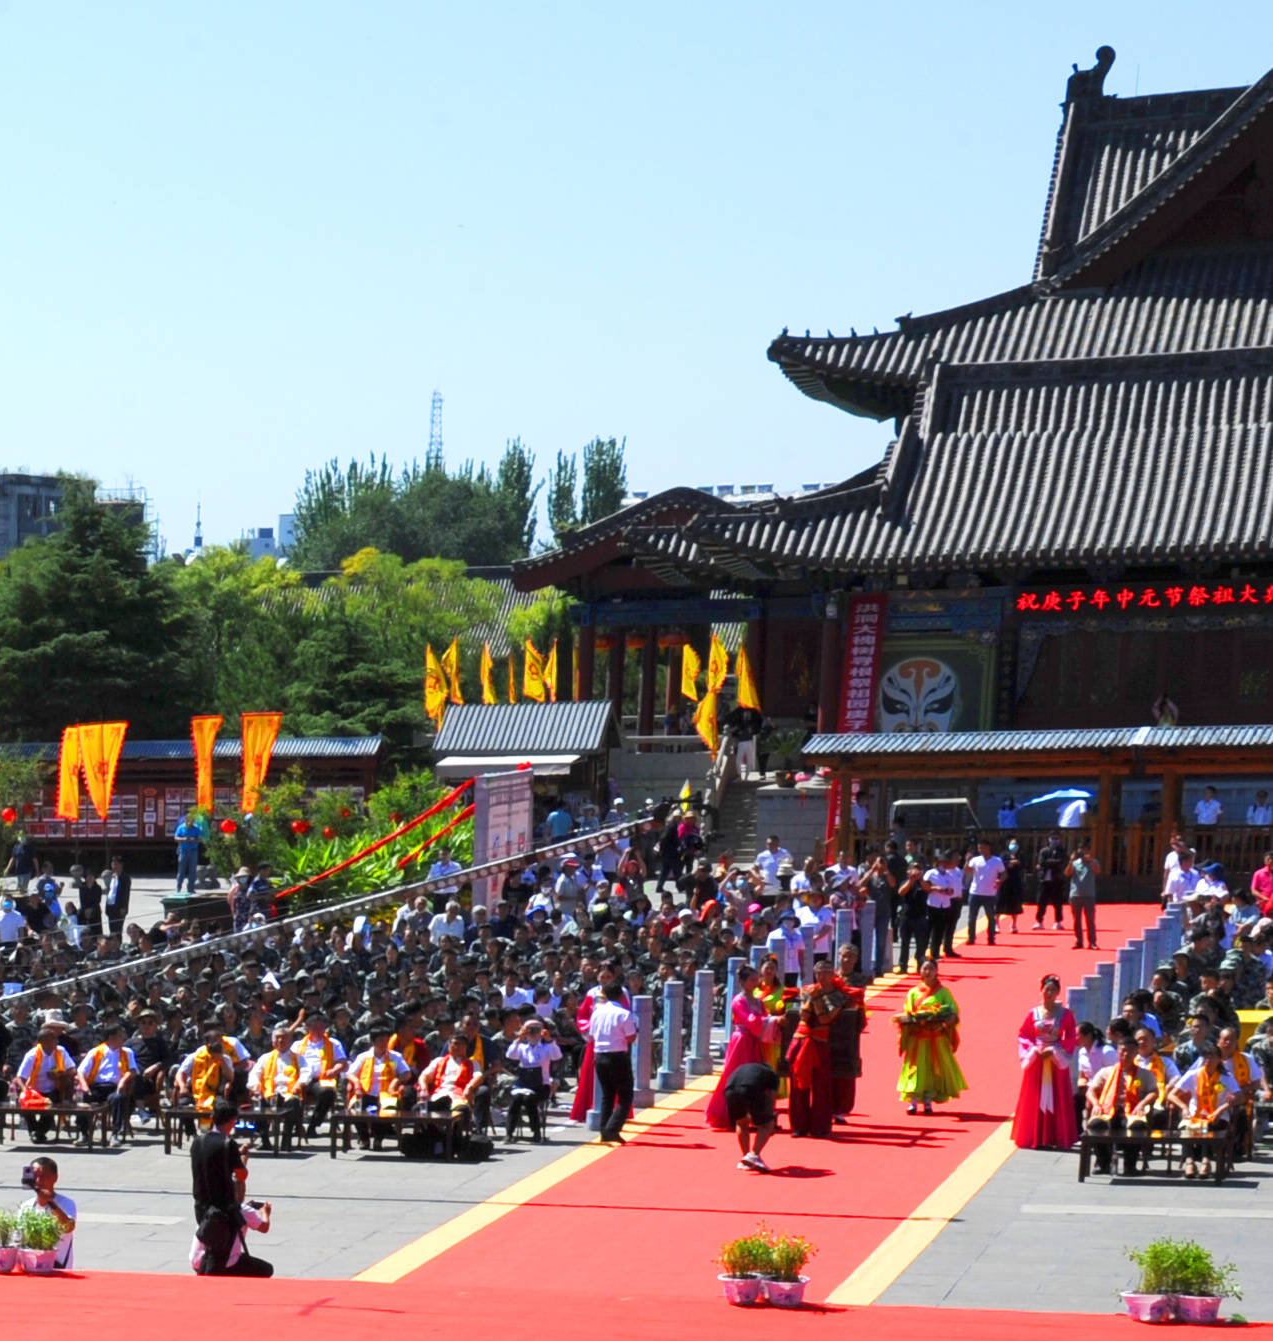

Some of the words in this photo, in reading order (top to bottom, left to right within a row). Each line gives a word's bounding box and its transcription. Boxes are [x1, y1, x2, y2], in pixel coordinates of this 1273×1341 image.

[844, 603, 880, 733] 洪洞大槐树寻根祭祖园庚子
